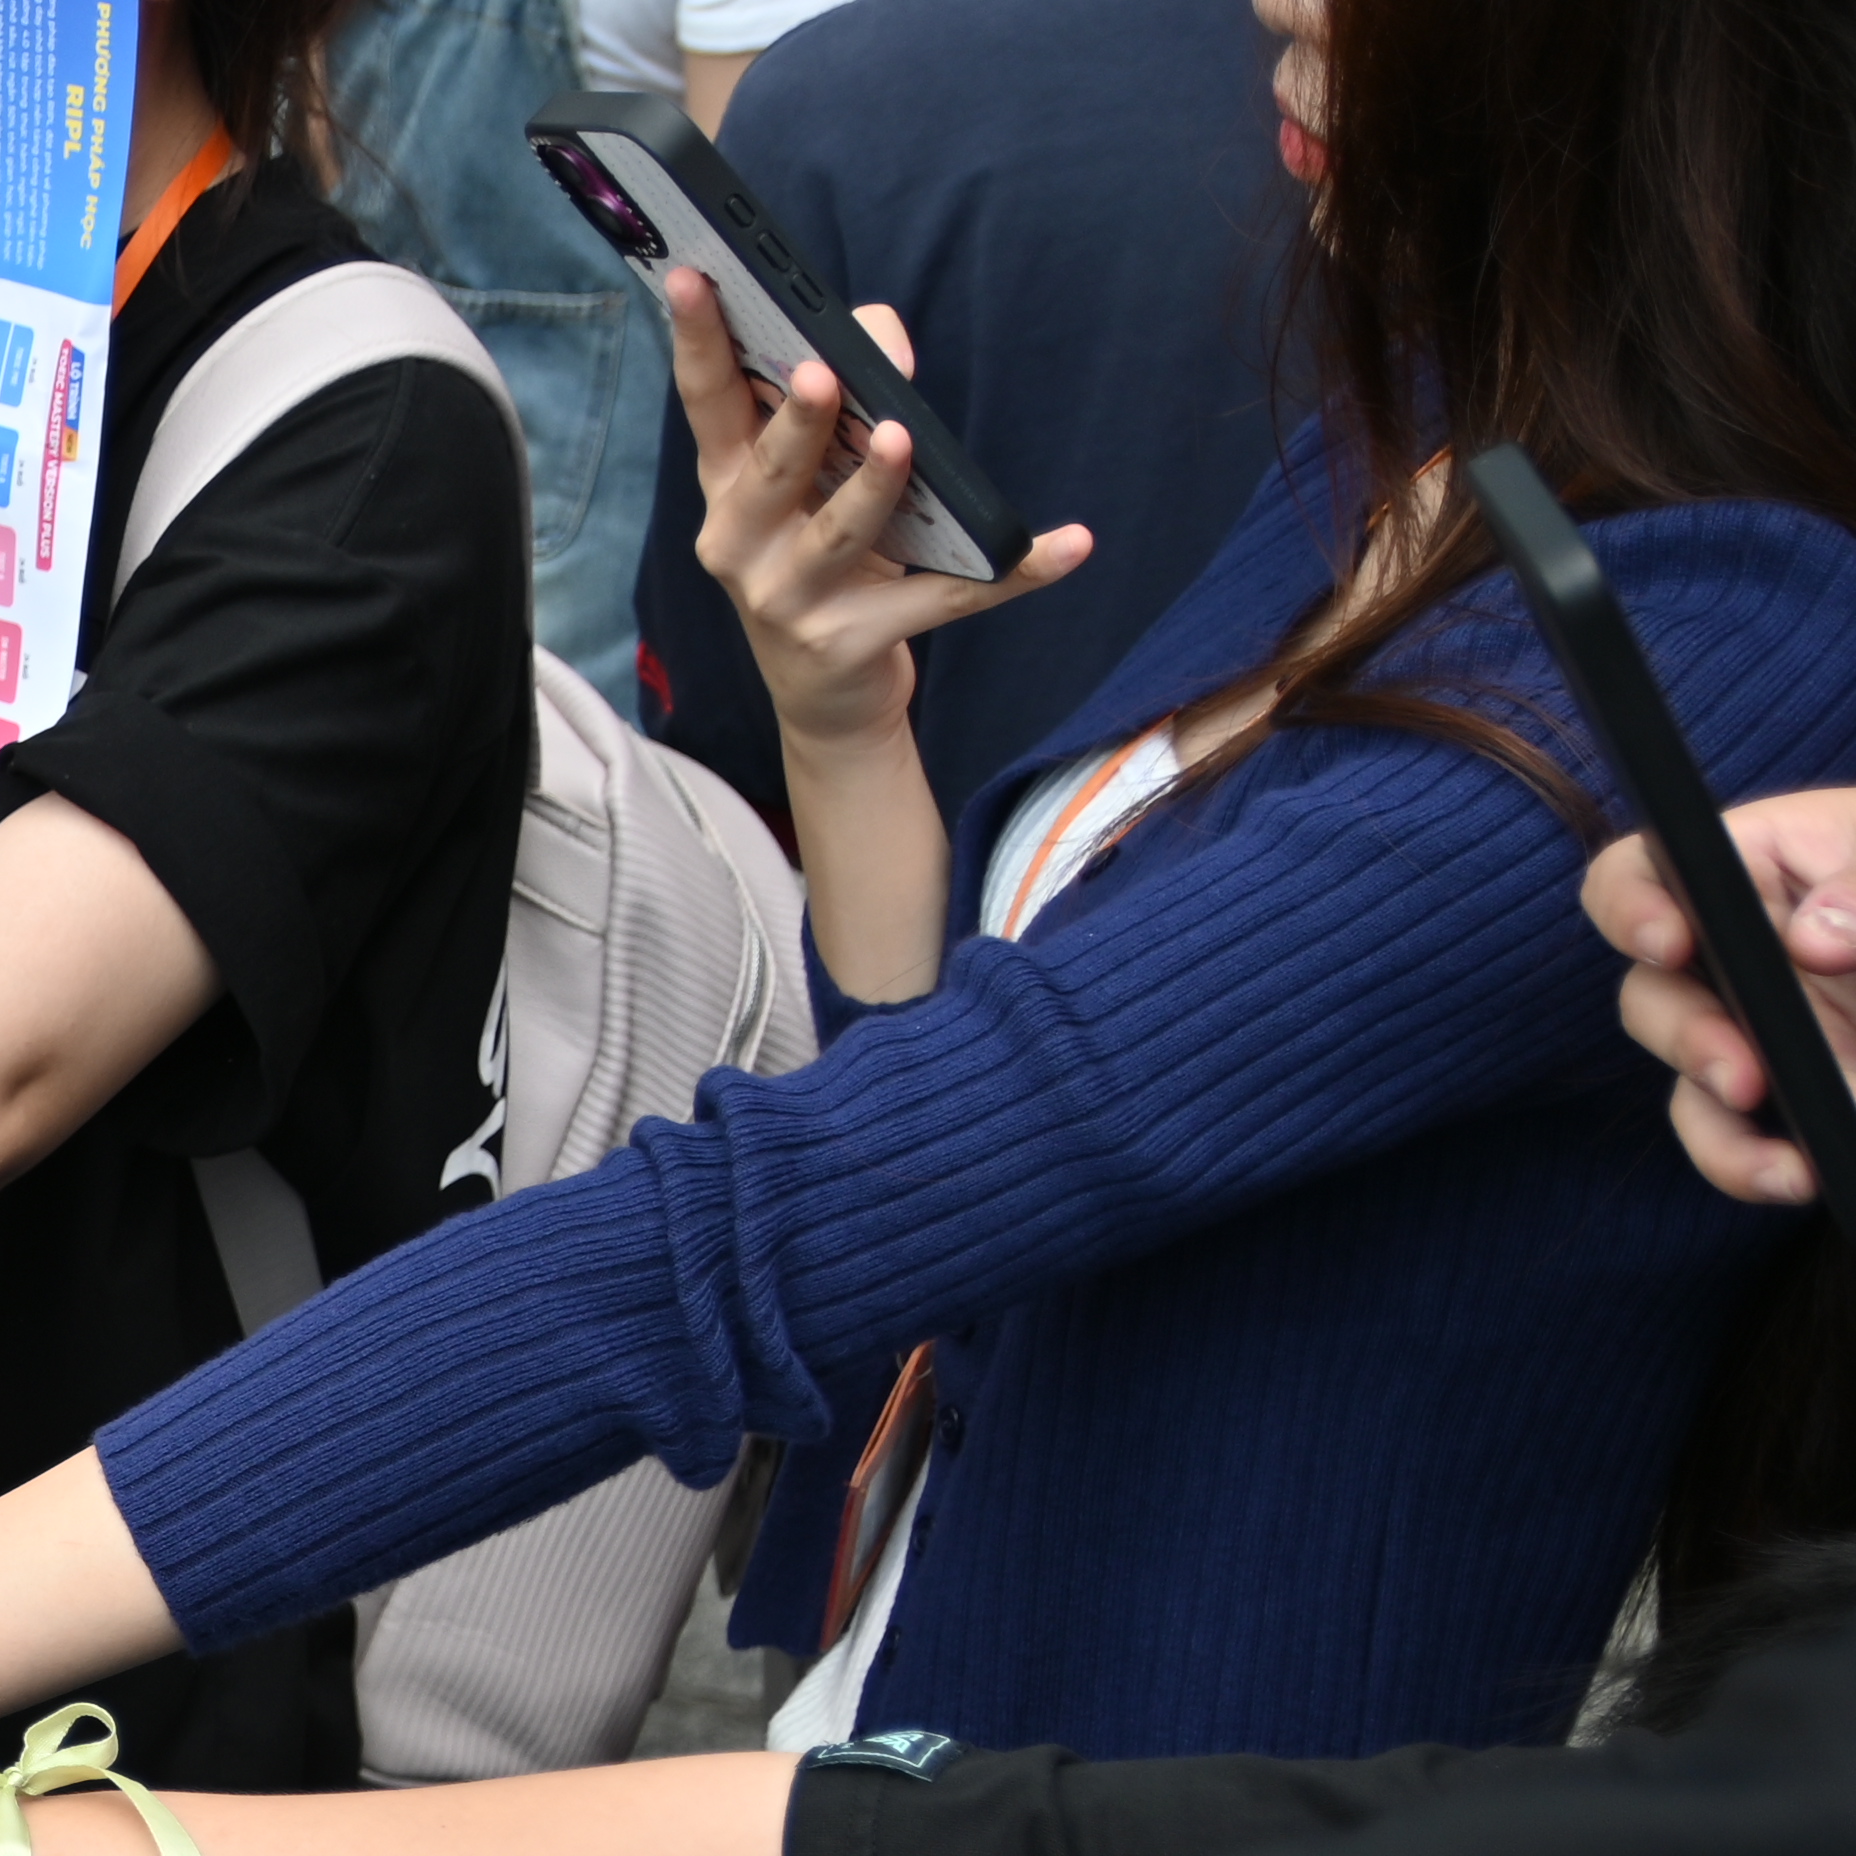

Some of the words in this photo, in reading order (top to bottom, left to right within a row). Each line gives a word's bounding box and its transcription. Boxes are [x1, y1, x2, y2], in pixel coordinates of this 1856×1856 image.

[93, 2, 112, 112] PHƯƠNG
[64, 84, 86, 160] RIPL
[88, 118, 106, 189] PHÁP
[80, 195, 100, 250] HỌC
[48, 391, 65, 457] MASTERY
[43, 459, 59, 521] VERSION
[40, 522, 52, 559] PLUS
